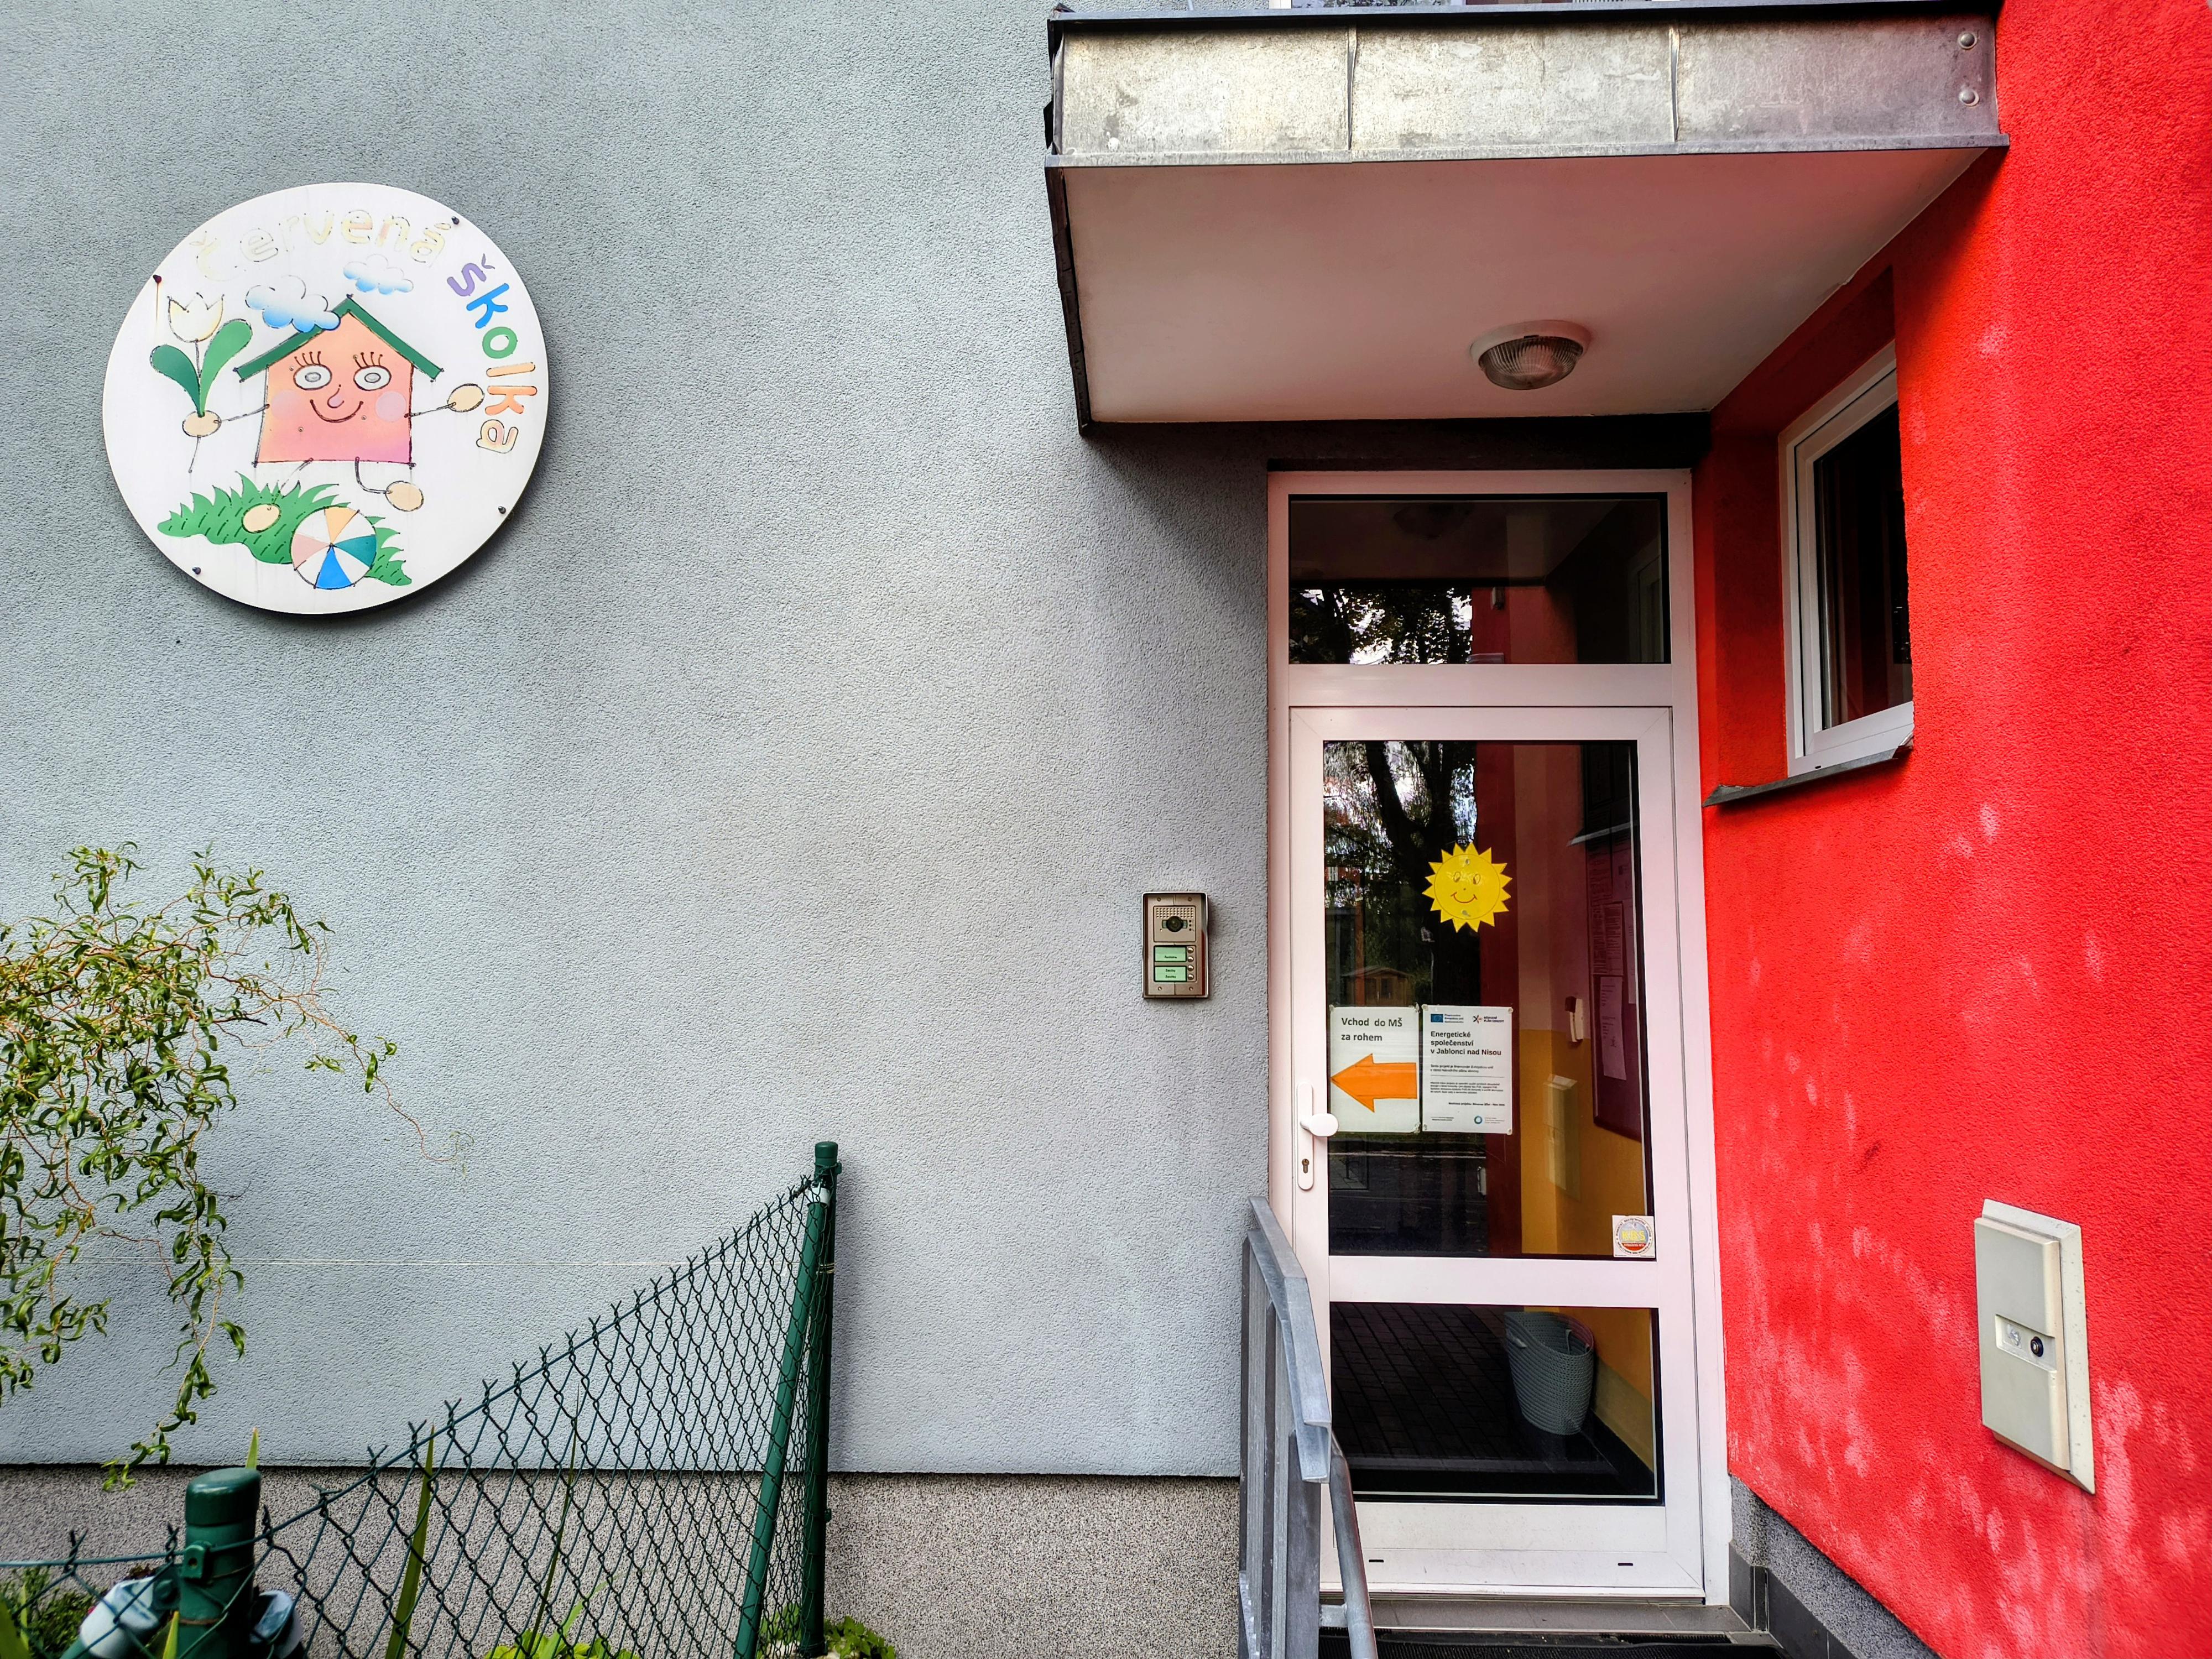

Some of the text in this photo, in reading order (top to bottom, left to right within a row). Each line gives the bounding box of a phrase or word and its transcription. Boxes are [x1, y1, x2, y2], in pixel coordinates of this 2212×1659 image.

[1341, 1018, 1402, 1027] Vchod do MŠ
[1353, 1033, 1383, 1041] rohem
